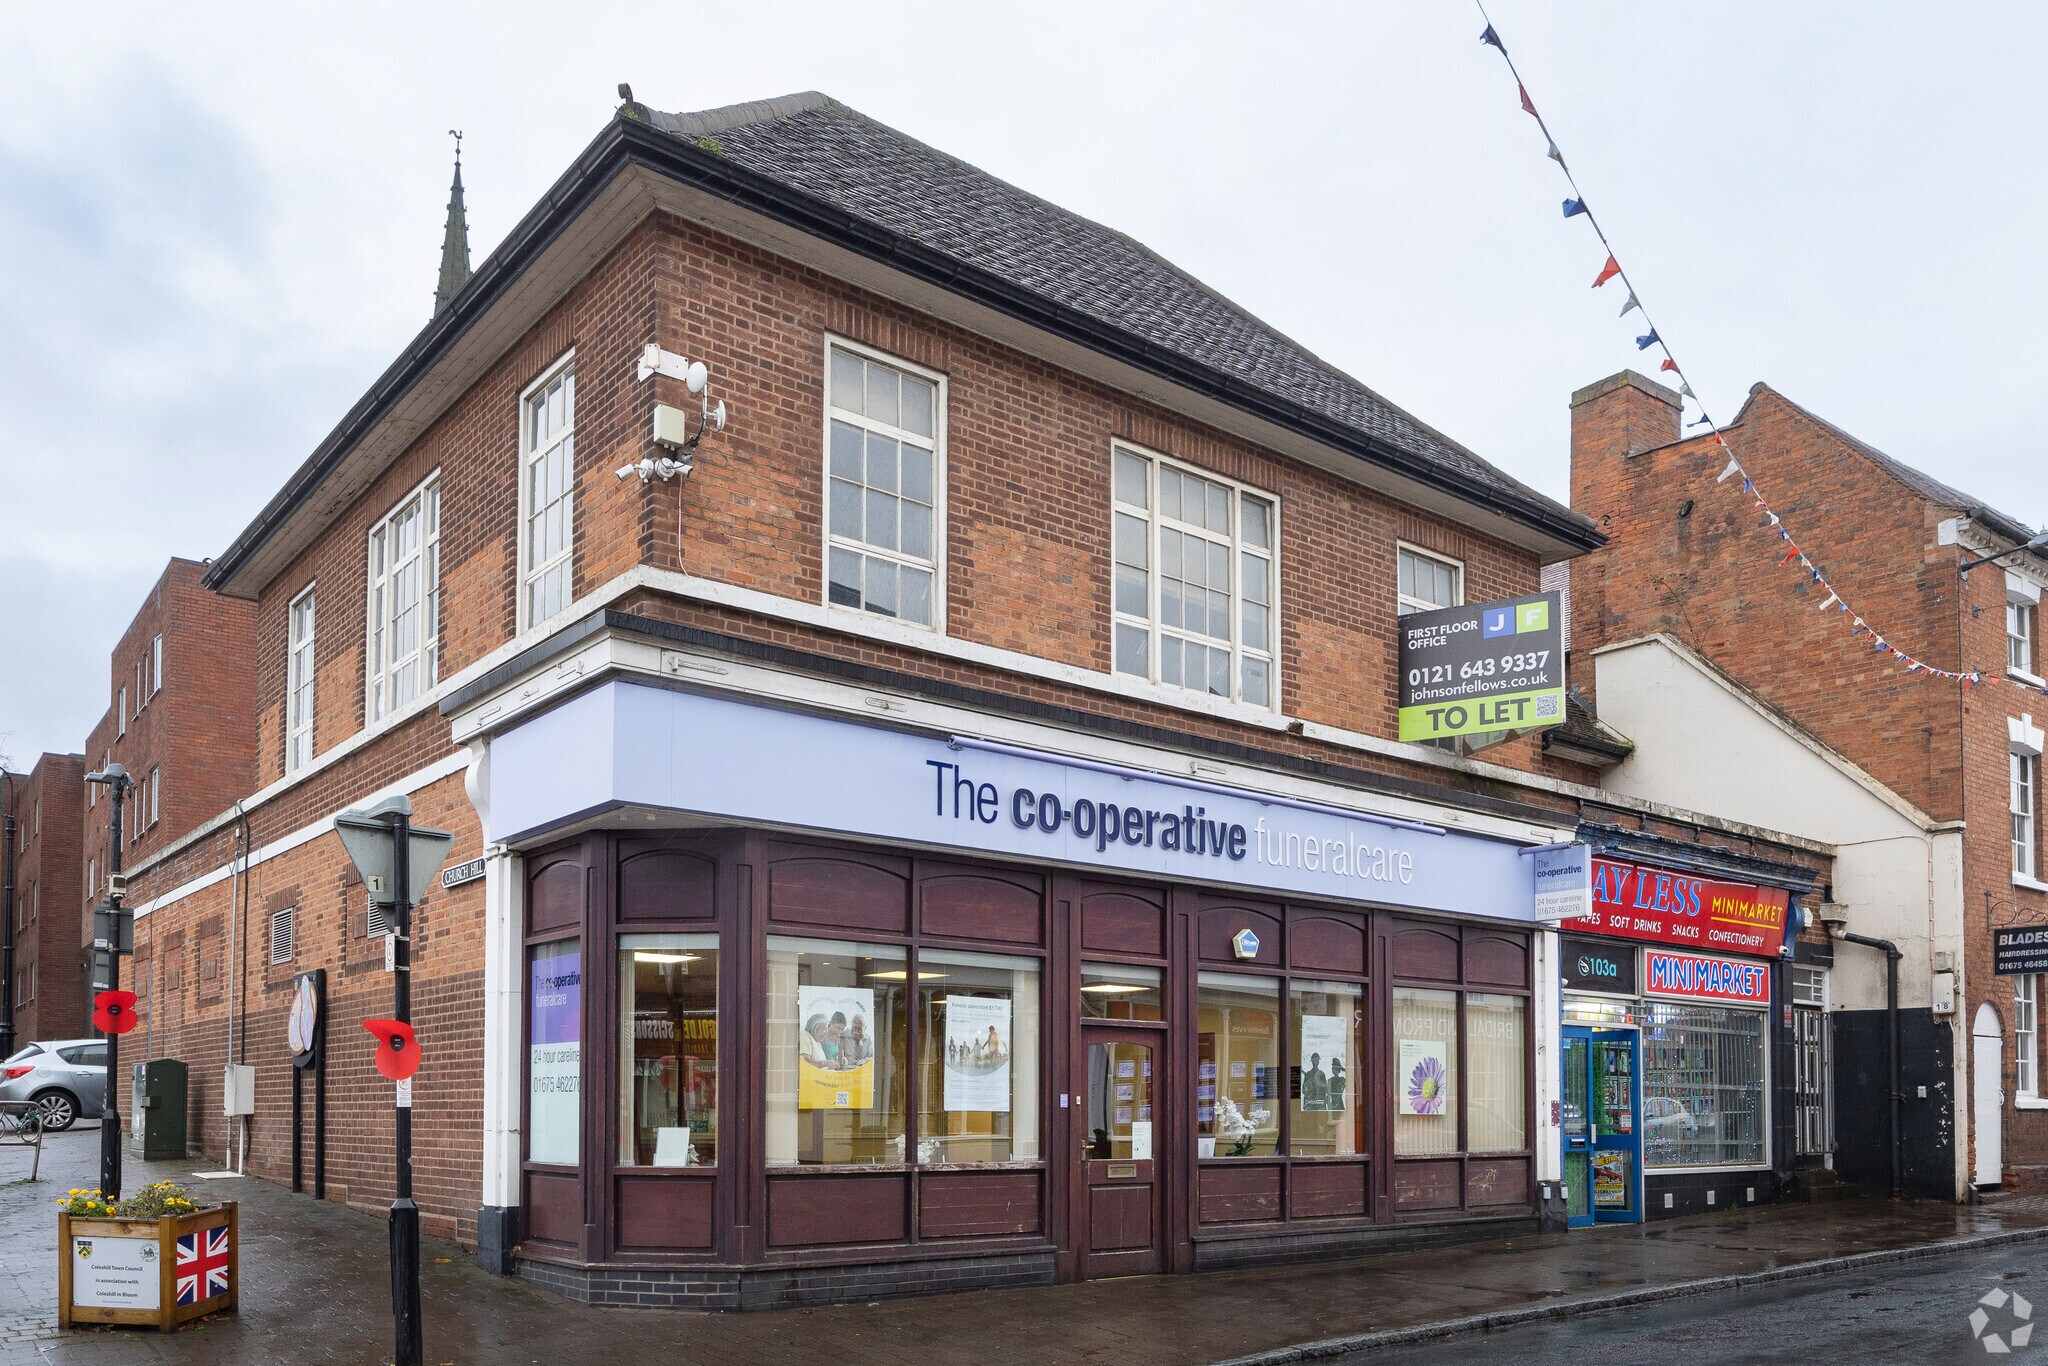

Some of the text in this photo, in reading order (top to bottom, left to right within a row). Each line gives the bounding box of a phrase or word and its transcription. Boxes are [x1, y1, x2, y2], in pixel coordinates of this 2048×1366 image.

[1489, 608, 1543, 632] J F
[1408, 620, 1478, 639] FIRST FLOOR
[1408, 636, 1447, 650] OFFICE
[1408, 650, 1550, 686] 0121 643 9337
[1410, 671, 1548, 703] johnsonfellows.co.uk
[1426, 697, 1531, 732] TO LET
[926, 760, 1414, 885] The co-operative funeralcare
[445, 860, 484, 884] CHURCH HILL
[1537, 859, 1549, 869] The
[1537, 865, 1582, 878] co-operative
[373, 878, 378, 890] 1
[1592, 864, 1703, 917] AY LESS
[1537, 894, 1582, 906] 24 hour careline
[1537, 906, 1556, 915] 01675
[1711, 895, 1783, 923] MINIMARKET
[1609, 915, 1630, 929] SOFT
[1633, 918, 1662, 933] DRINKS
[1672, 924, 1699, 939] SNACKS
[1708, 929, 1764, 947] CONFECTIONERY
[1999, 948, 2048, 958] HAIRDRESSIN
[1590, 957, 1617, 977] 103a
[1999, 959, 2048, 970] 01675 46458
[535, 975, 545, 990] The
[535, 992, 567, 1008] funeralcare
[533, 1047, 580, 1064] 24 hour careline
[533, 1076, 554, 1093] 01675
